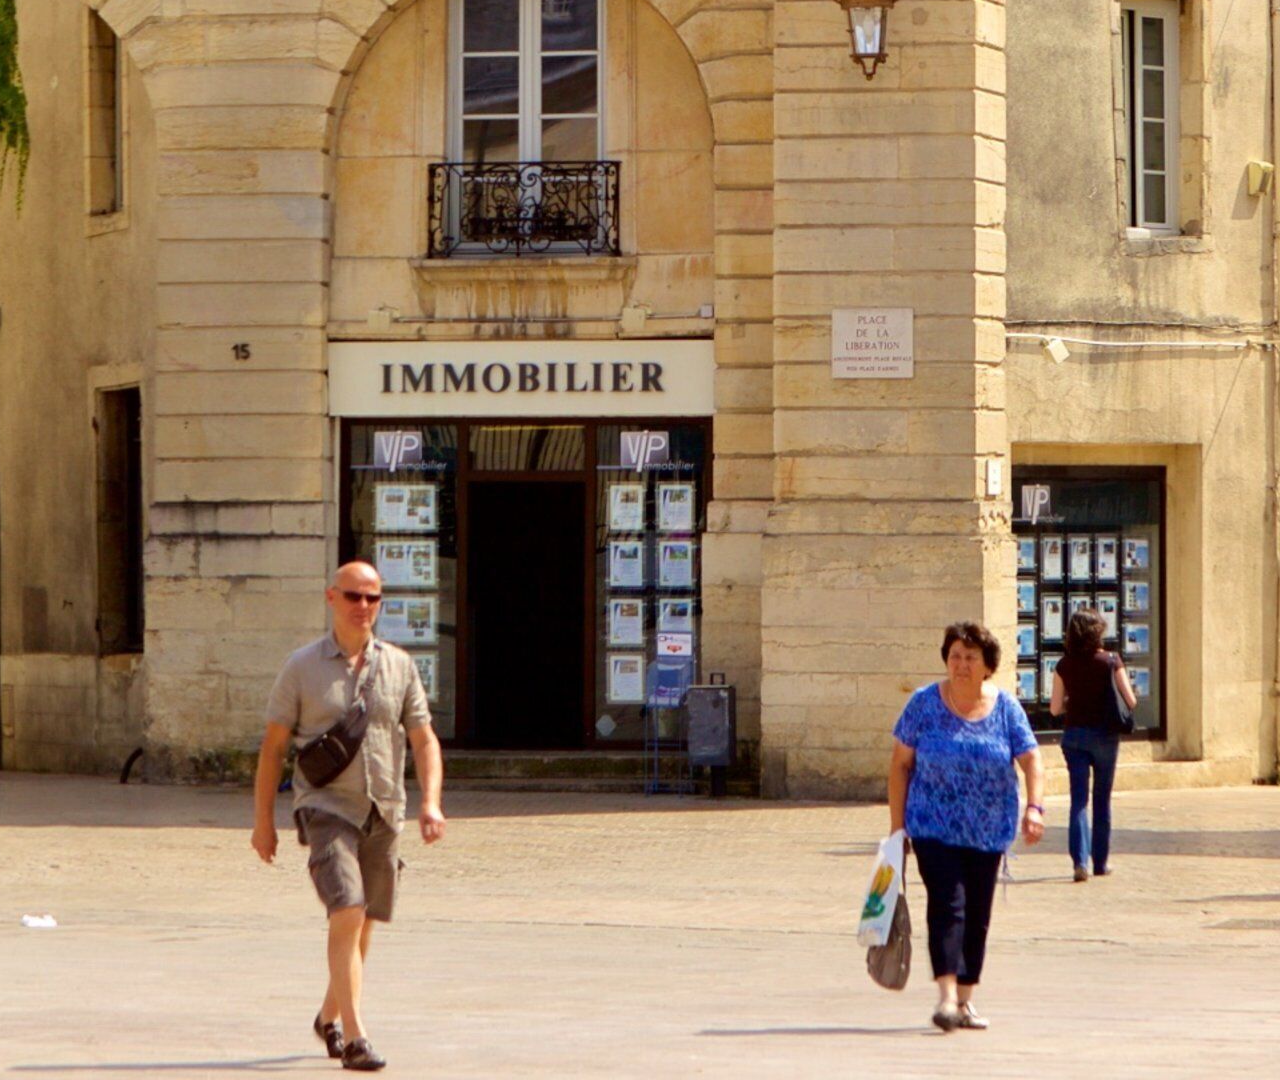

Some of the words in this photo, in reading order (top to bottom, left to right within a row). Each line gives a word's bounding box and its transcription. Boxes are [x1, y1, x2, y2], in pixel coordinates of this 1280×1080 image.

[857, 315, 888, 325] PLACE
[844, 340, 900, 351] LIBERATION
[856, 328, 868, 338] DE
[876, 328, 890, 338] LA
[231, 343, 251, 361] 15
[380, 361, 666, 394] IMMOBILIER
[380, 430, 419, 473] VIP
[626, 430, 666, 473] VIP
[1025, 484, 1050, 525] VIP
